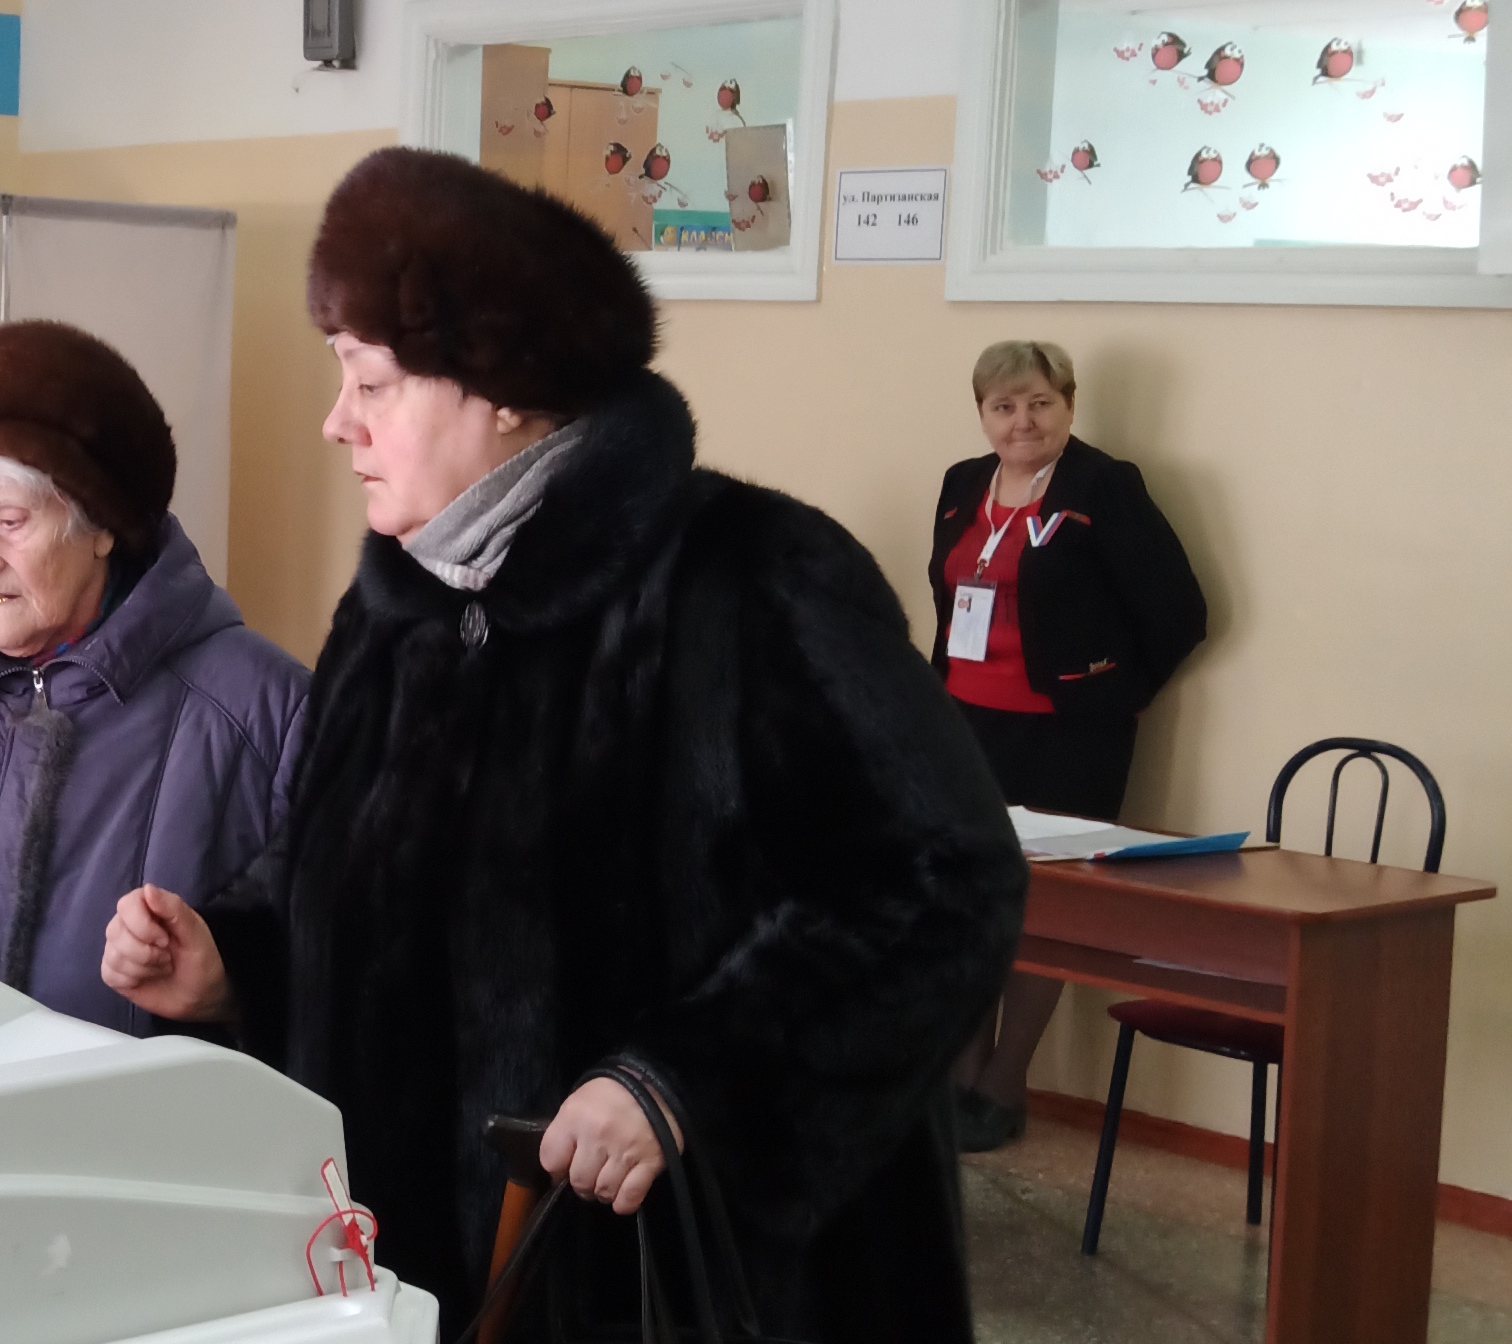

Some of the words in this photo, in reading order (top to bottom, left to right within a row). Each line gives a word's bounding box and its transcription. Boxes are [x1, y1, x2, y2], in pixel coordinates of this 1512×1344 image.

[842, 194, 858, 206] ул.
[862, 191, 939, 205] Партизанская
[857, 213, 878, 227] 142
[897, 213, 919, 227] 146
